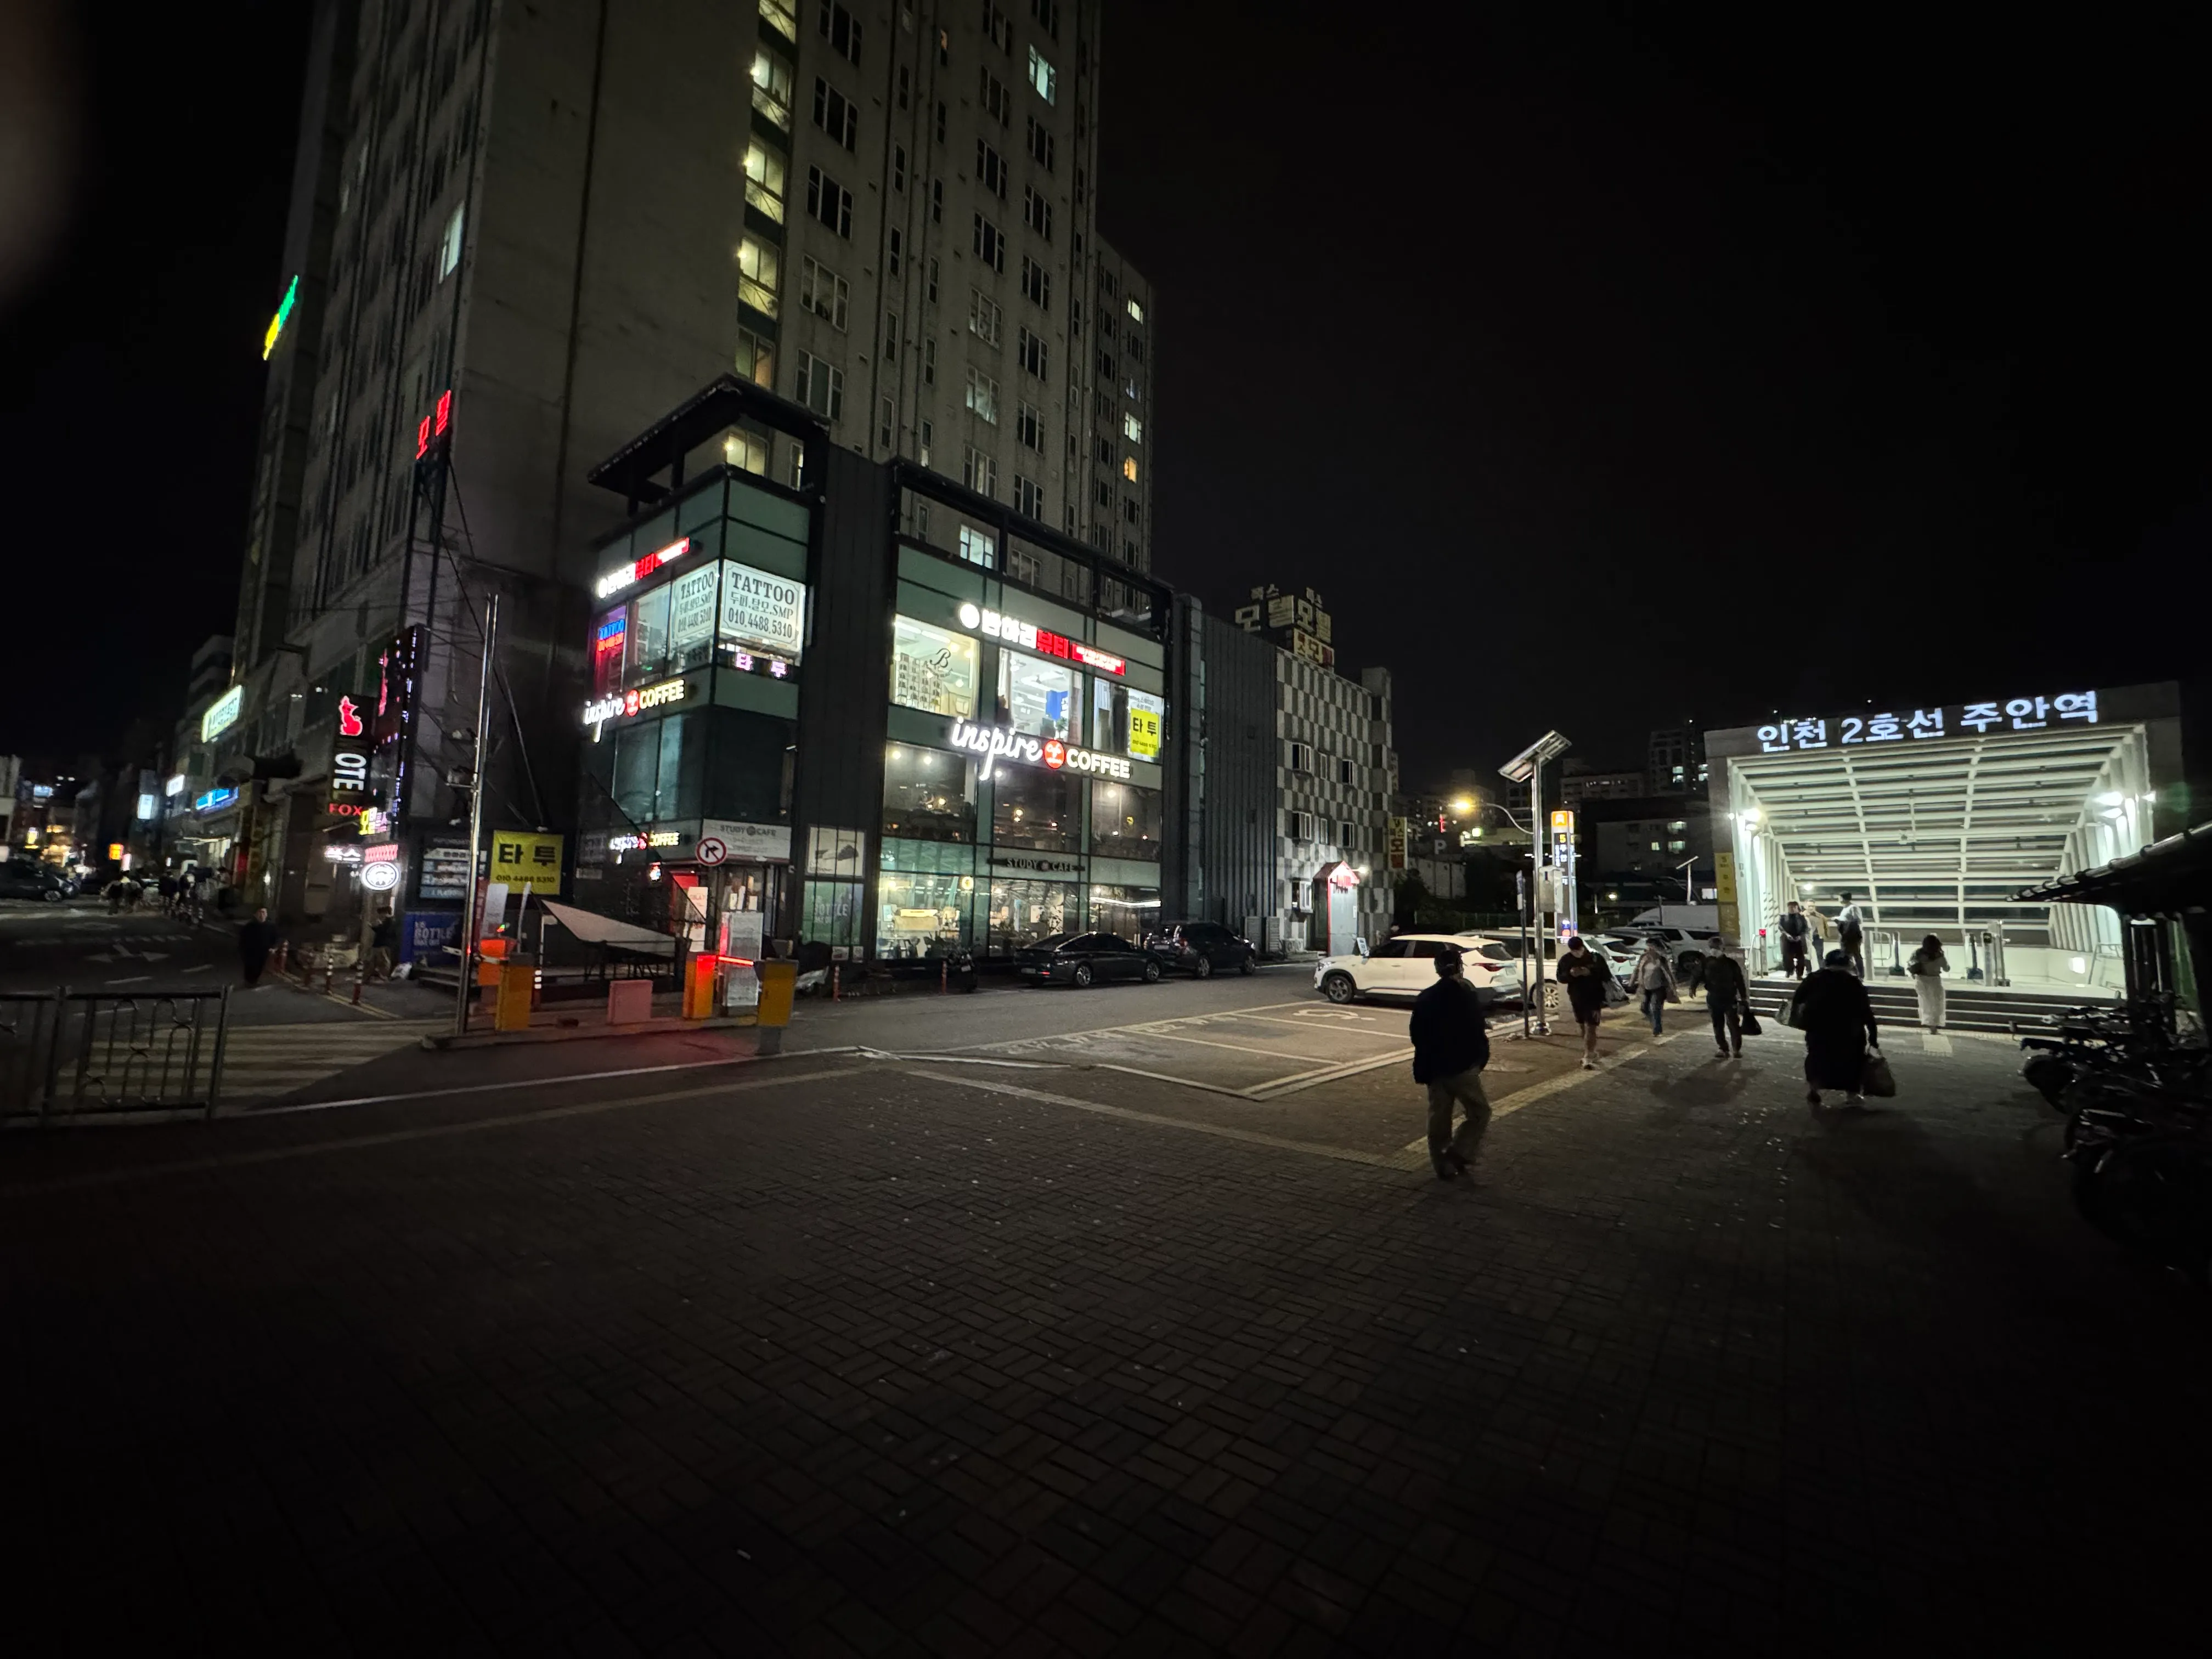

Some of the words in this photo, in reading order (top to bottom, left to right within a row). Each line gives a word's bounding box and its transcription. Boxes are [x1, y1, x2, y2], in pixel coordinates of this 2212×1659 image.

[681, 571, 714, 599] TATTOO
[732, 572, 794, 605] TATTOO
[731, 592, 793, 620] 두피.탈모.SMP
[729, 608, 792, 638] 010.4488.5310
[583, 692, 625, 742] inspire
[640, 680, 685, 709] COFFEE
[1757, 720, 1827, 753] 인천
[1841, 708, 1945, 744] 2호선
[1960, 690, 2098, 732] 주안역
[952, 716, 1042, 781] inspire
[1066, 748, 1130, 779] COFFEE
[330, 803, 362, 816] FOX
[720, 825, 746, 834] STUDY
[1559, 834, 1566, 843] 5
[1435, 839, 1447, 854] P
[1007, 858, 1039, 870] STUDY
[1052, 862, 1074, 871] CAFE
